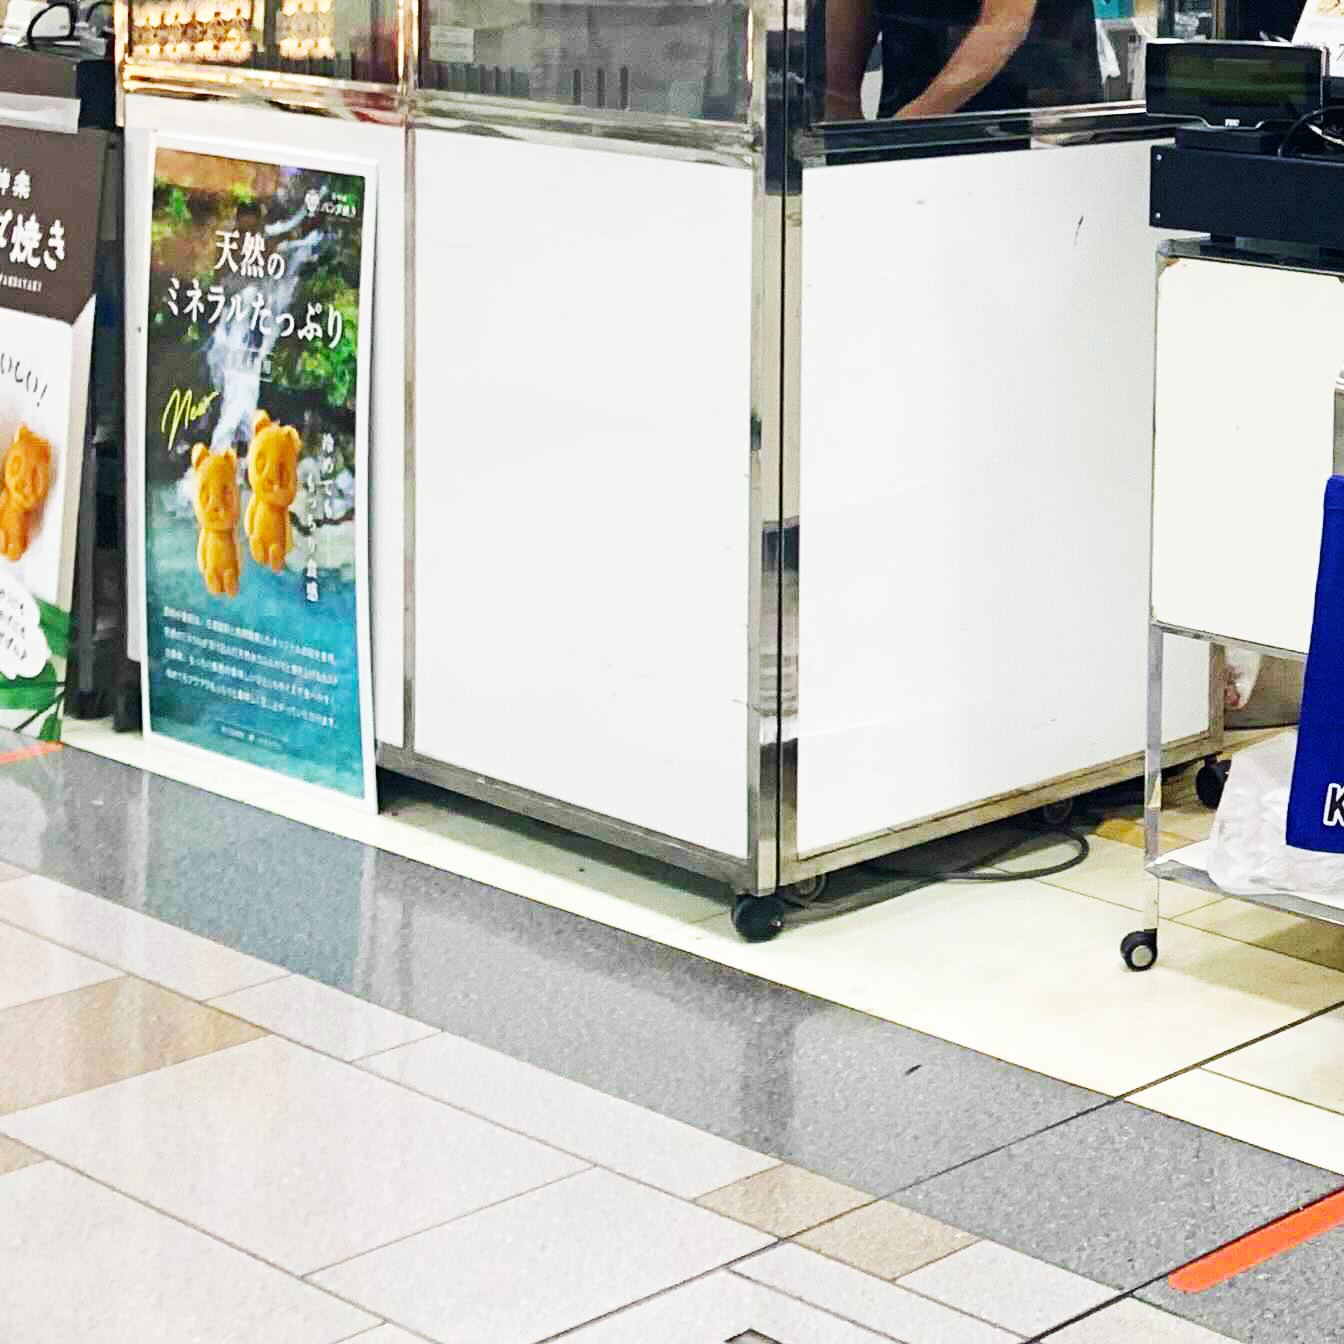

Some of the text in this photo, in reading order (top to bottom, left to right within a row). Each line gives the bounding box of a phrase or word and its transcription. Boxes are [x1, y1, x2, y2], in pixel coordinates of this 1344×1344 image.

[214, 229, 285, 279] 天然の
[167, 277, 343, 348] ミネラルたっぷり
